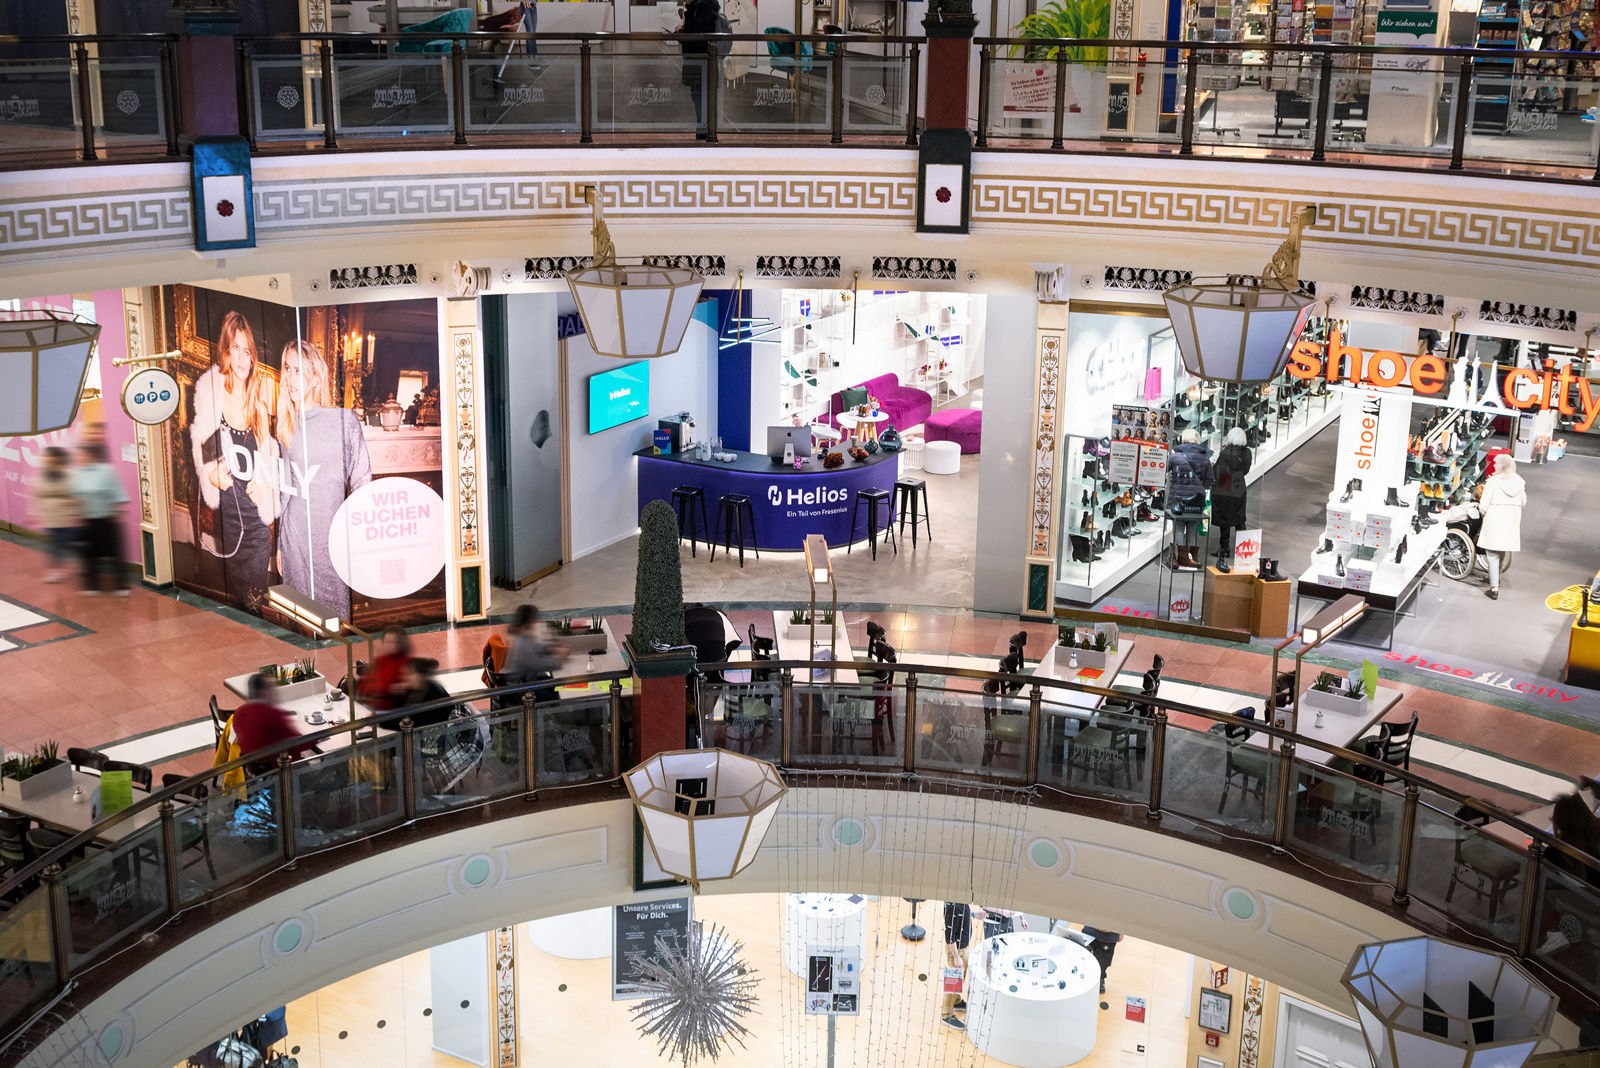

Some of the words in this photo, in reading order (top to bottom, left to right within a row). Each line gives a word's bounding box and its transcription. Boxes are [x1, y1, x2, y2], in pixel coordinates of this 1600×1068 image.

[1380, 18, 1394, 27] Wir
[1417, 19, 1434, 28] um!
[1286, 331, 1447, 396] shoe
[1503, 358, 1600, 432] city
[1354, 417, 1376, 470] shoe
[229, 443, 321, 501] ONLY
[371, 491, 409, 507] WIR
[787, 486, 848, 505] Helios
[350, 504, 431, 526] SUCHEN
[821, 507, 848, 516] Fresenius
[365, 522, 418, 541] DICH!
[1238, 545, 1257, 553] SALE
[1383, 652, 1475, 679] shoe
[1515, 683, 1582, 704] city
[622, 904, 649, 912] Unsere
[650, 902, 682, 911] Services.
[650, 911, 669, 919] Dich.
